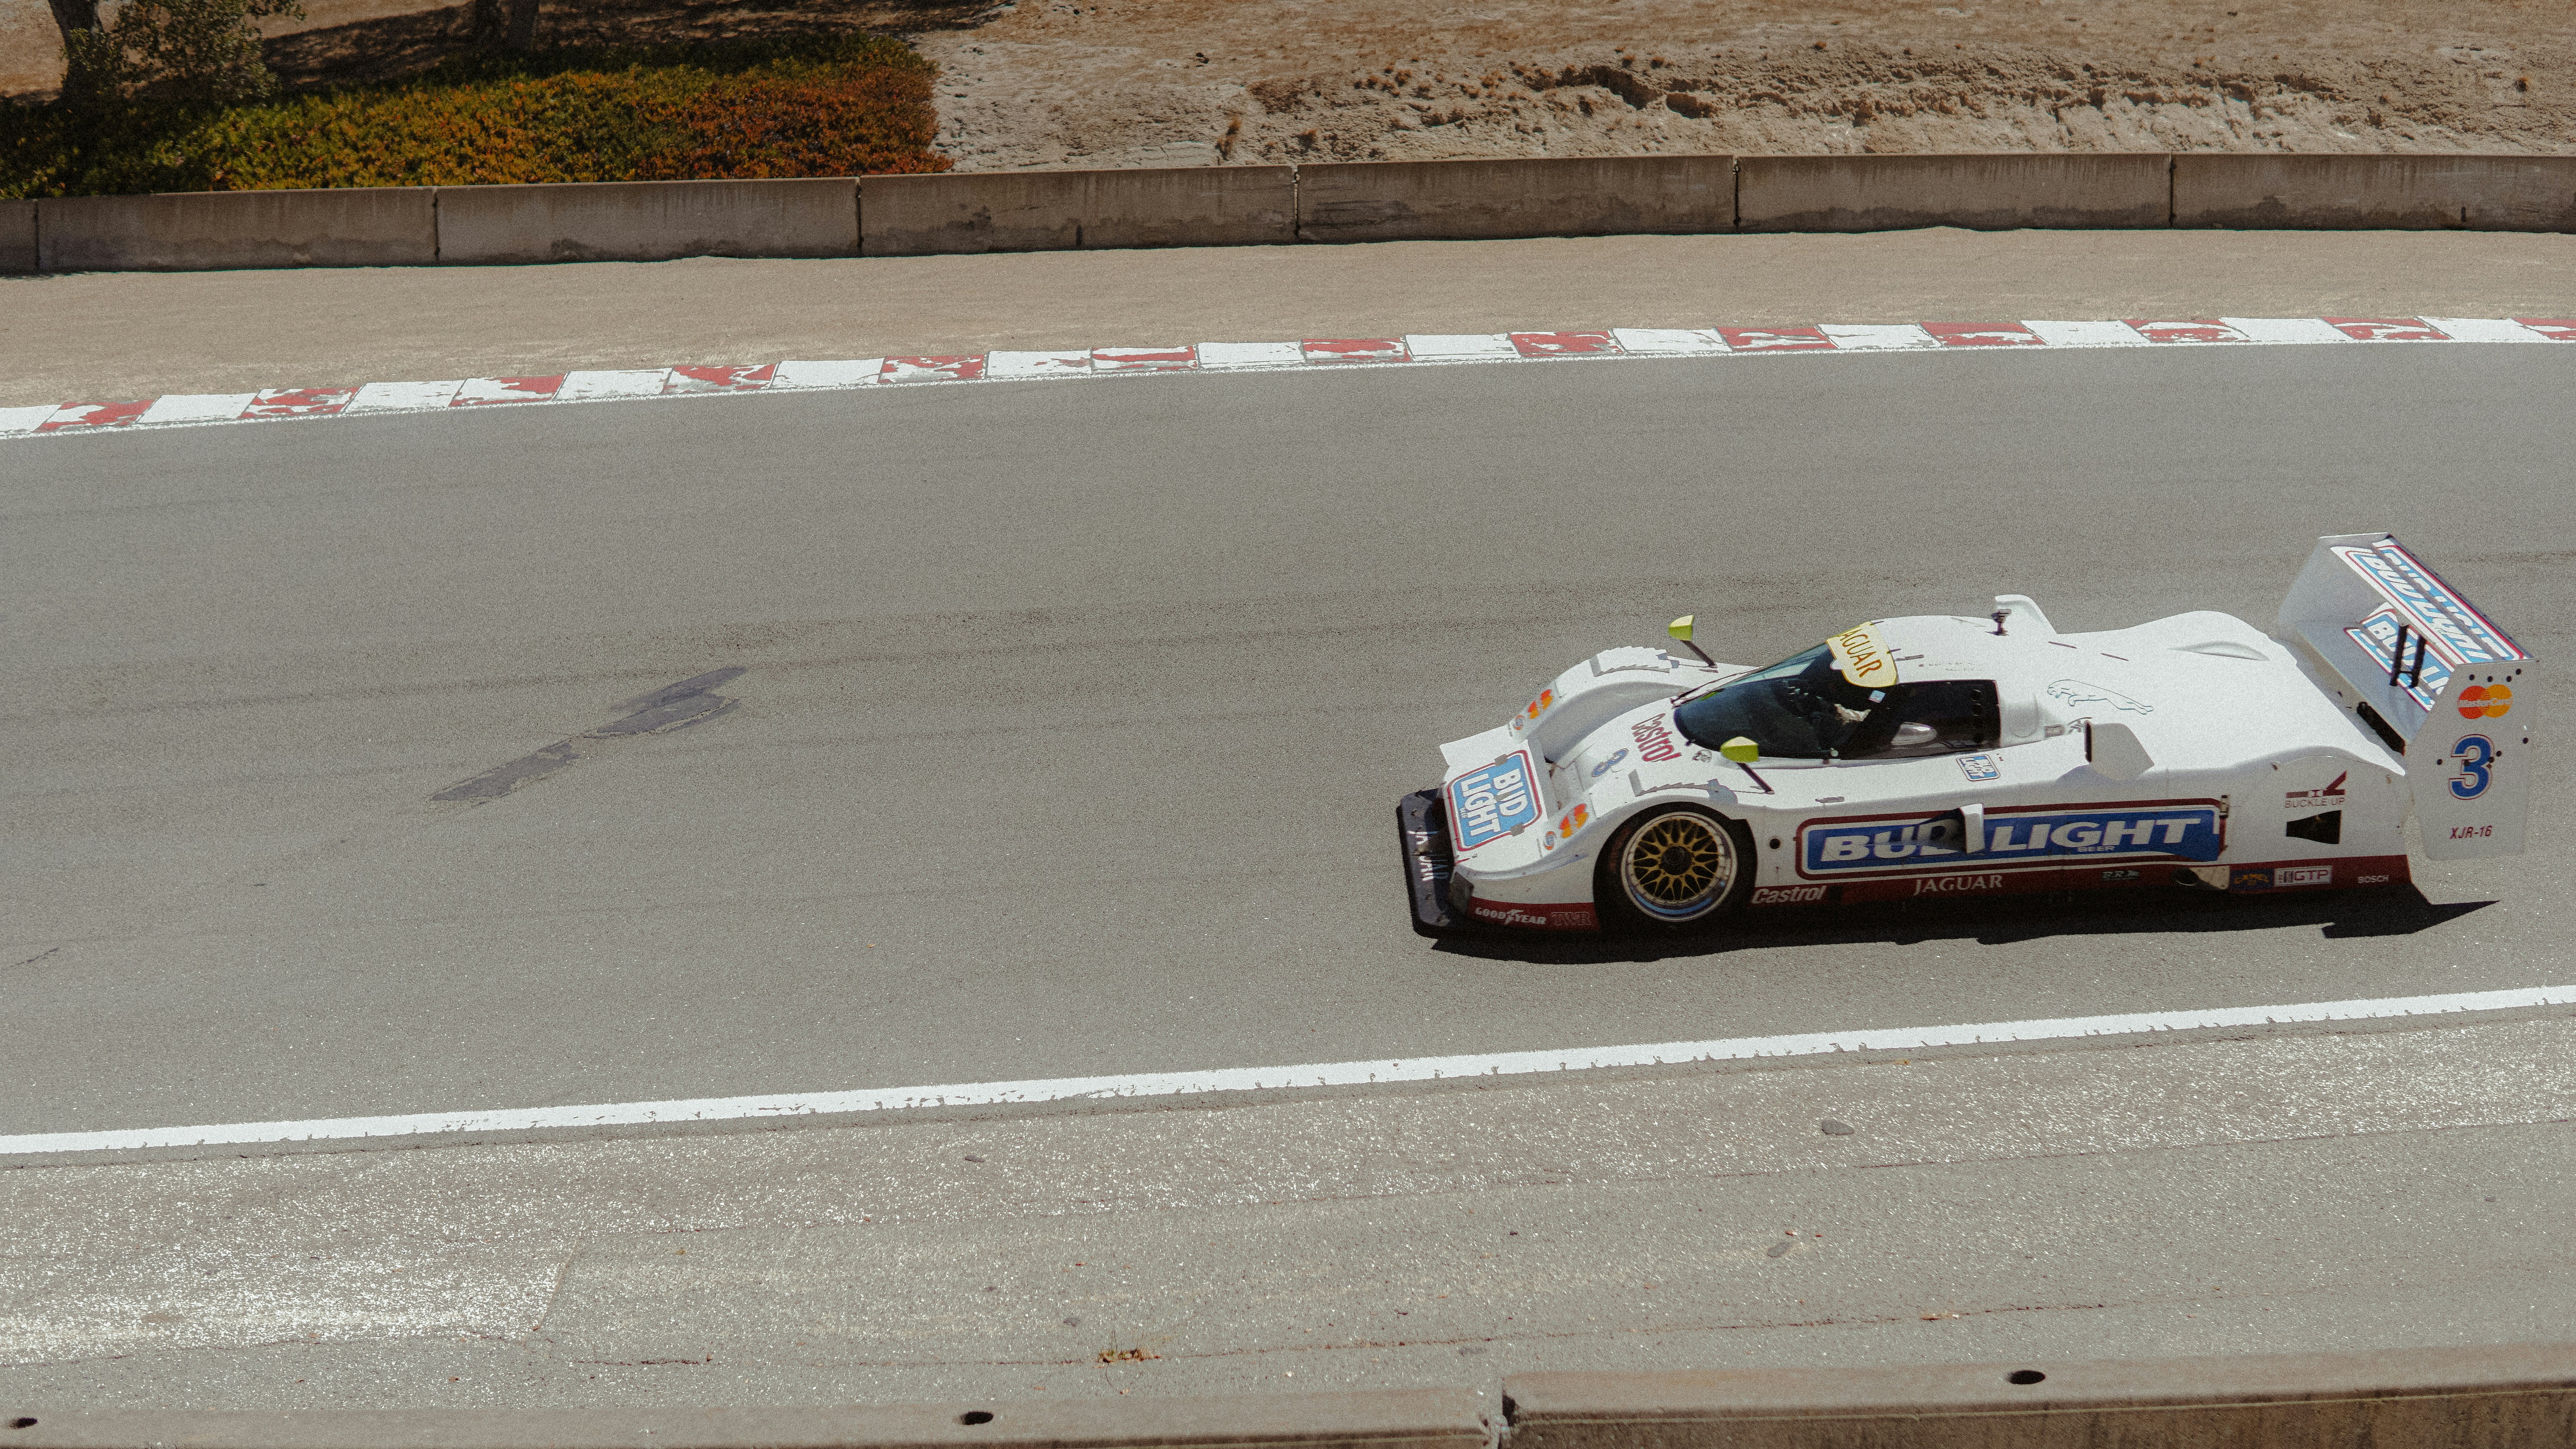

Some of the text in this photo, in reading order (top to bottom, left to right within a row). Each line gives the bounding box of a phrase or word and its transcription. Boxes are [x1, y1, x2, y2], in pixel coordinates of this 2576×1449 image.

[1835, 627, 1883, 678] AGUAR
[1631, 713, 1683, 763] Castrol
[2448, 734, 2495, 800] 3
[1461, 773, 1501, 836] LIGHT
[1493, 768, 1528, 816] BUD
[2285, 797, 2345, 808] BUCKLE UP
[1820, 818, 2202, 861] BUD LIGHT
[2449, 825, 2493, 839] XJR-16
[1407, 830, 1450, 881] JAUAR
[2294, 869, 2329, 881] GTP
[1751, 885, 1827, 904] Castrol
[1913, 875, 2003, 896] JAGUAR
[2357, 875, 2389, 883] BOSCH
